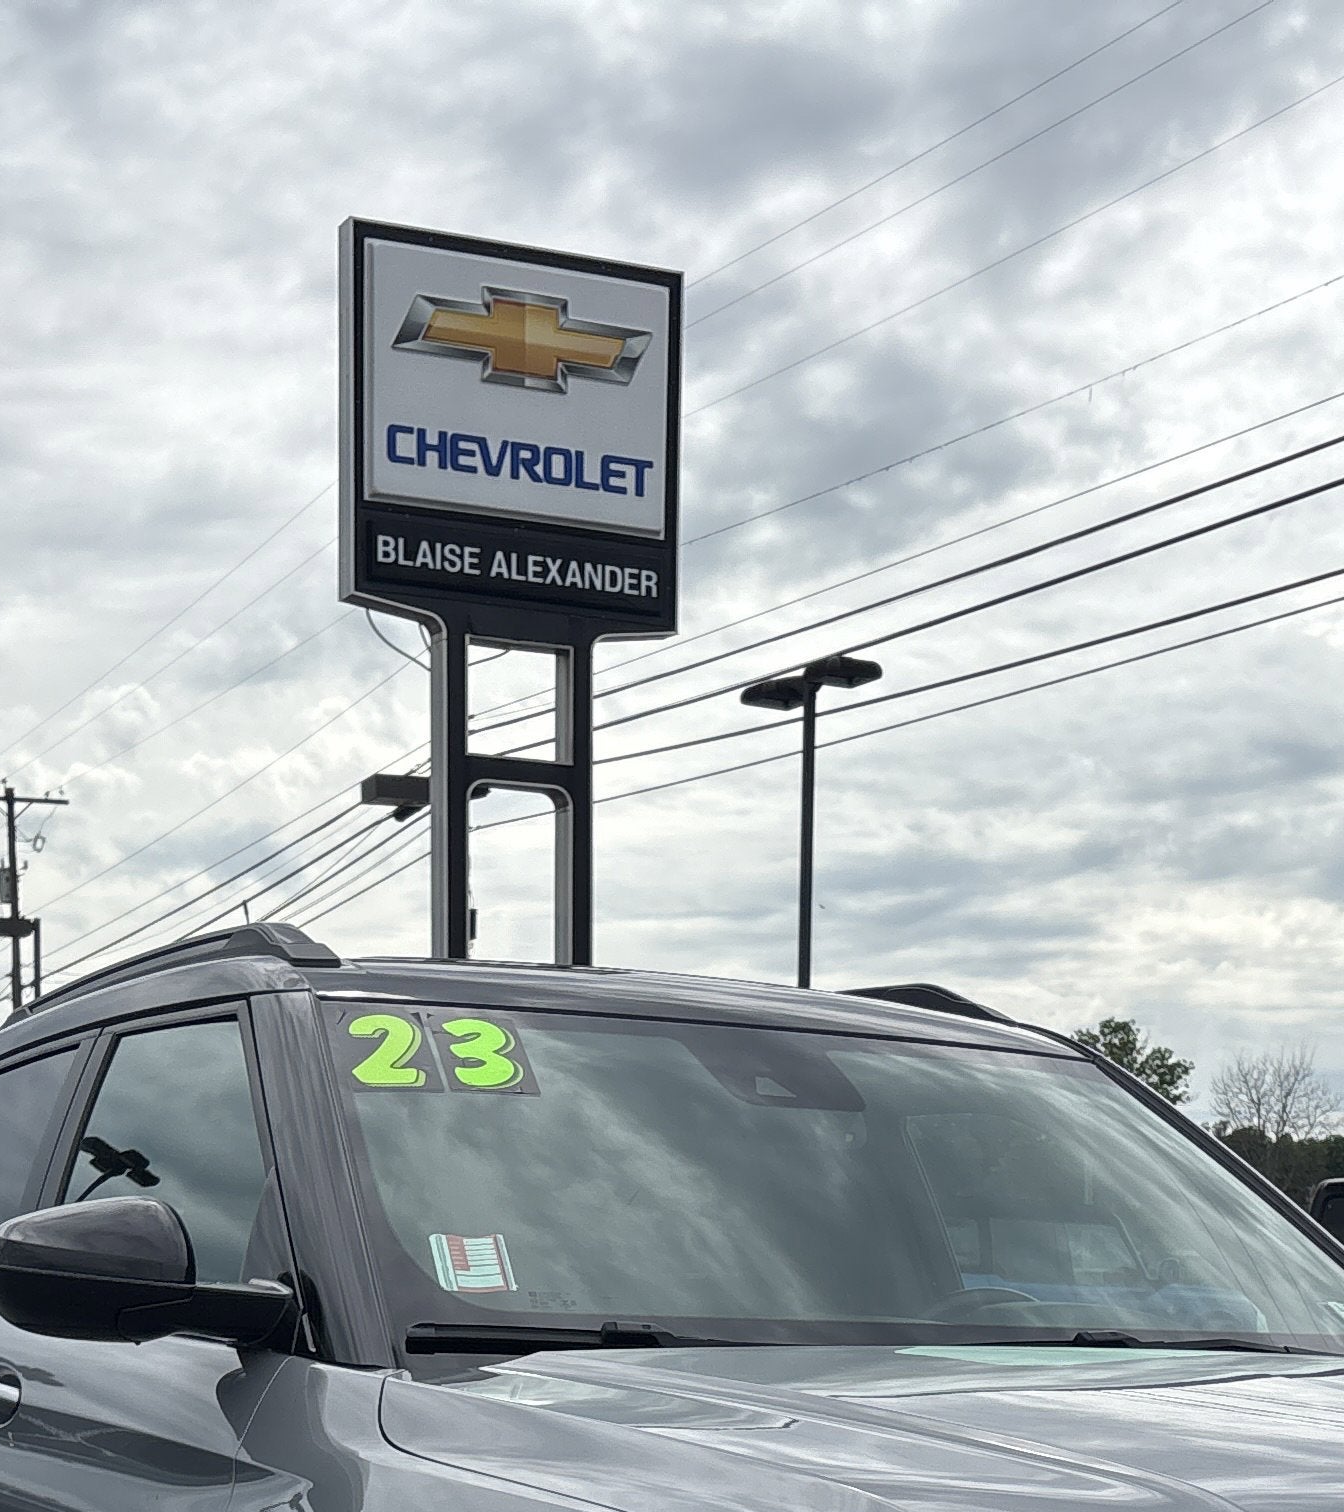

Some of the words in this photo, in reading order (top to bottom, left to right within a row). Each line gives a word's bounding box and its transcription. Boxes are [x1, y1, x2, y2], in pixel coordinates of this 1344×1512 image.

[387, 424, 654, 497] CHEVROLET
[376, 534, 482, 576] BLAISE
[490, 550, 659, 598] ALEXANDER
[347, 1014, 525, 1090] 23
